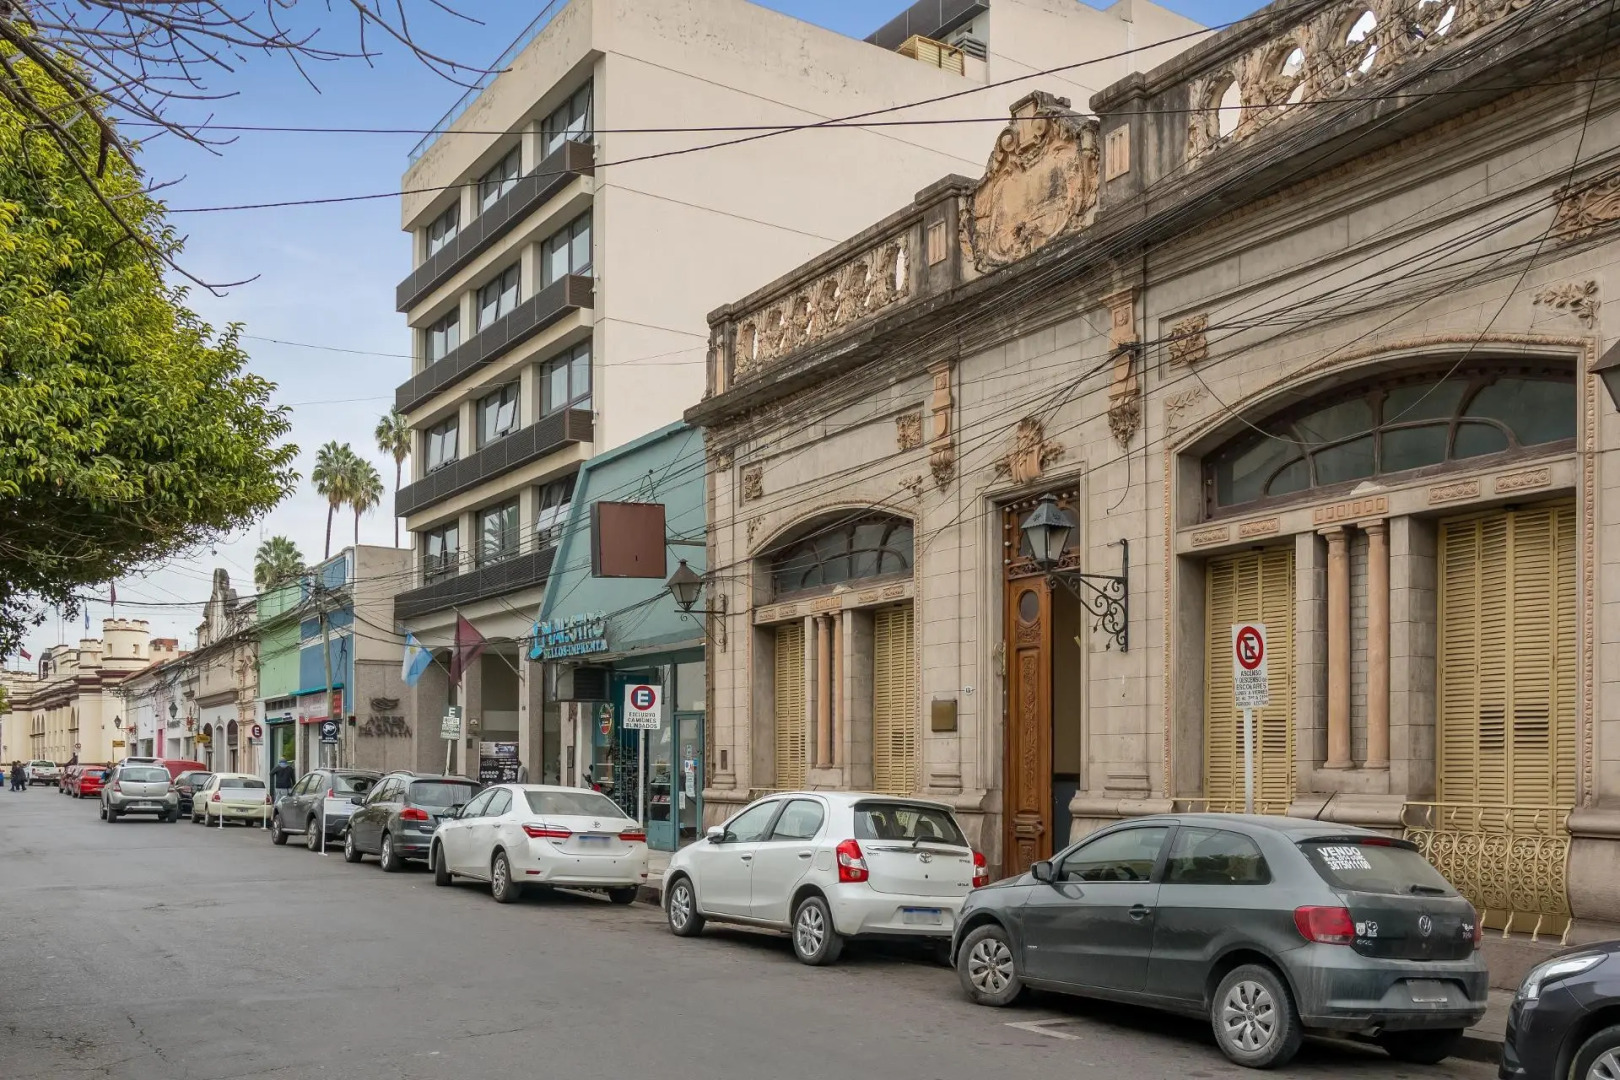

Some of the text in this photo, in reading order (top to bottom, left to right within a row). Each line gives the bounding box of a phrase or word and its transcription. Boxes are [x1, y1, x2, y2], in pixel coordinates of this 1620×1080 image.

[1244, 637, 1257, 659] E
[637, 690, 649, 706] E
[449, 707, 456, 718] E
[254, 726, 260, 736] E
[1316, 846, 1361, 857] VENDO
